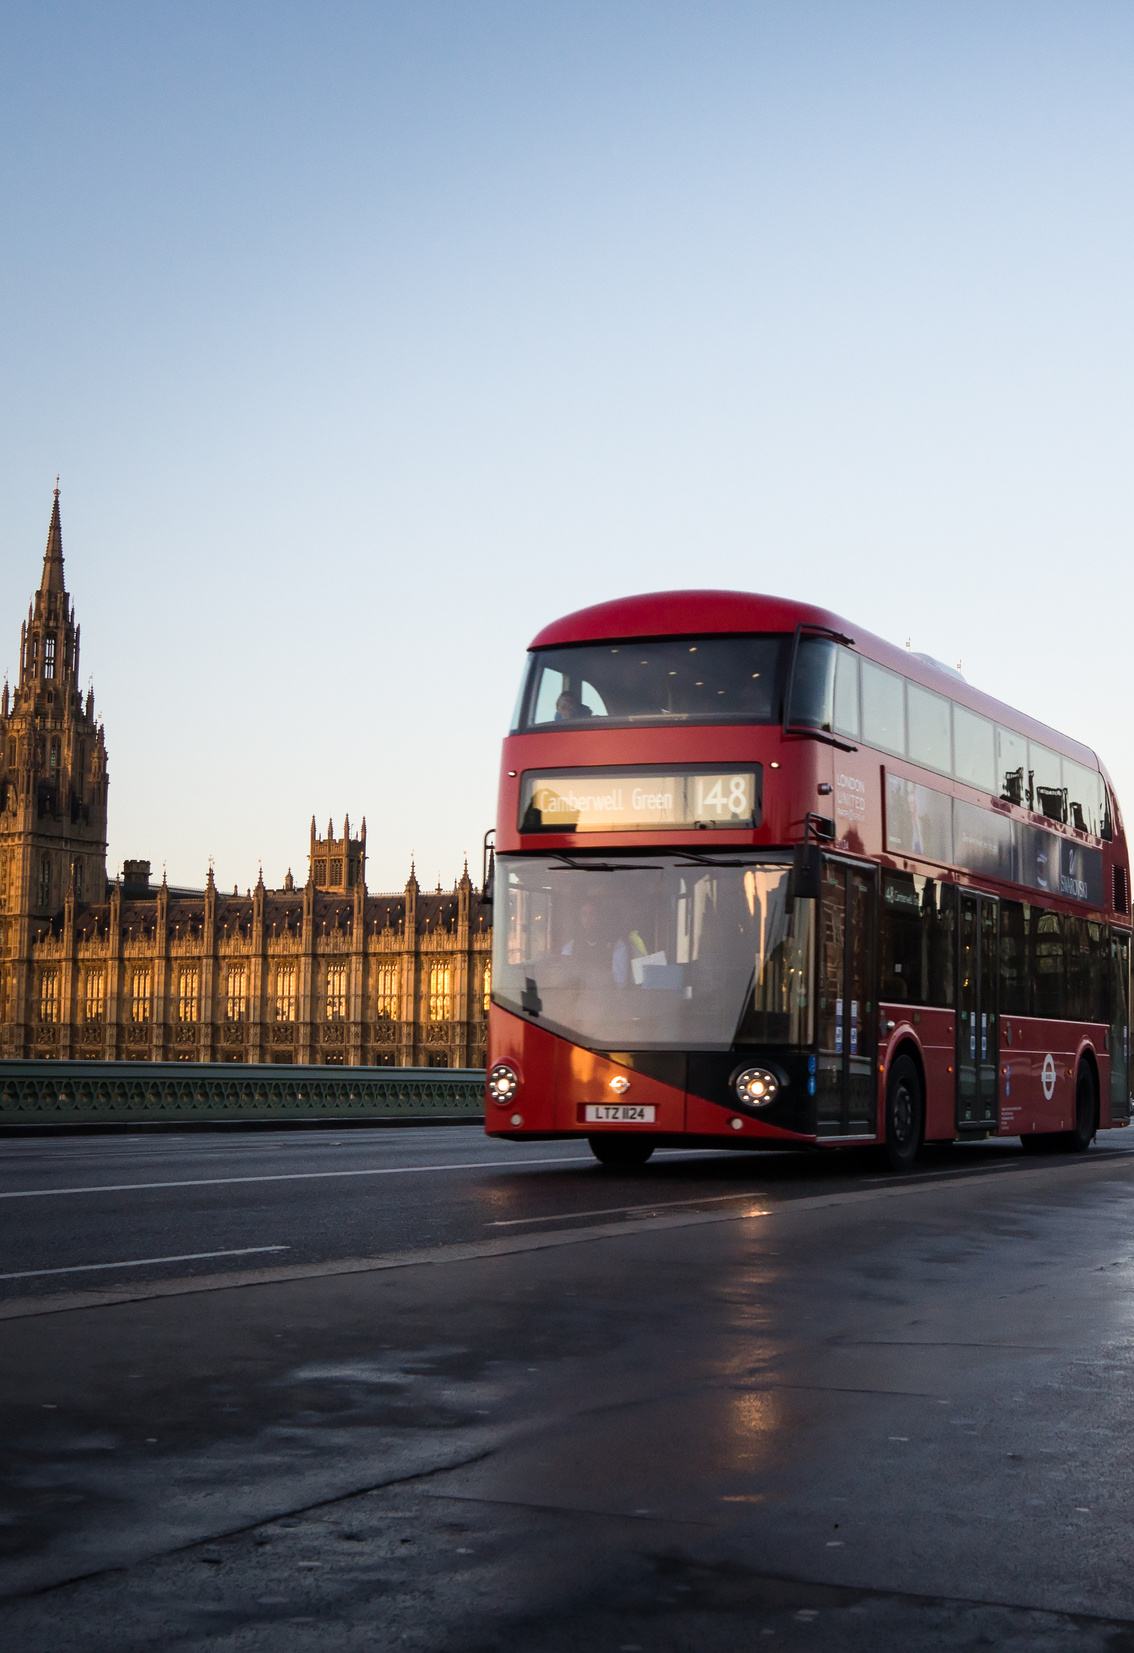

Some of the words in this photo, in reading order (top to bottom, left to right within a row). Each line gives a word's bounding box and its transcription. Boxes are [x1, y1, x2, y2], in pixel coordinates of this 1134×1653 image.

[539, 787, 624, 813] Camberwell
[631, 787, 673, 811] Green
[697, 776, 747, 815] 148
[1060, 874, 1088, 899] SWAROVSKI
